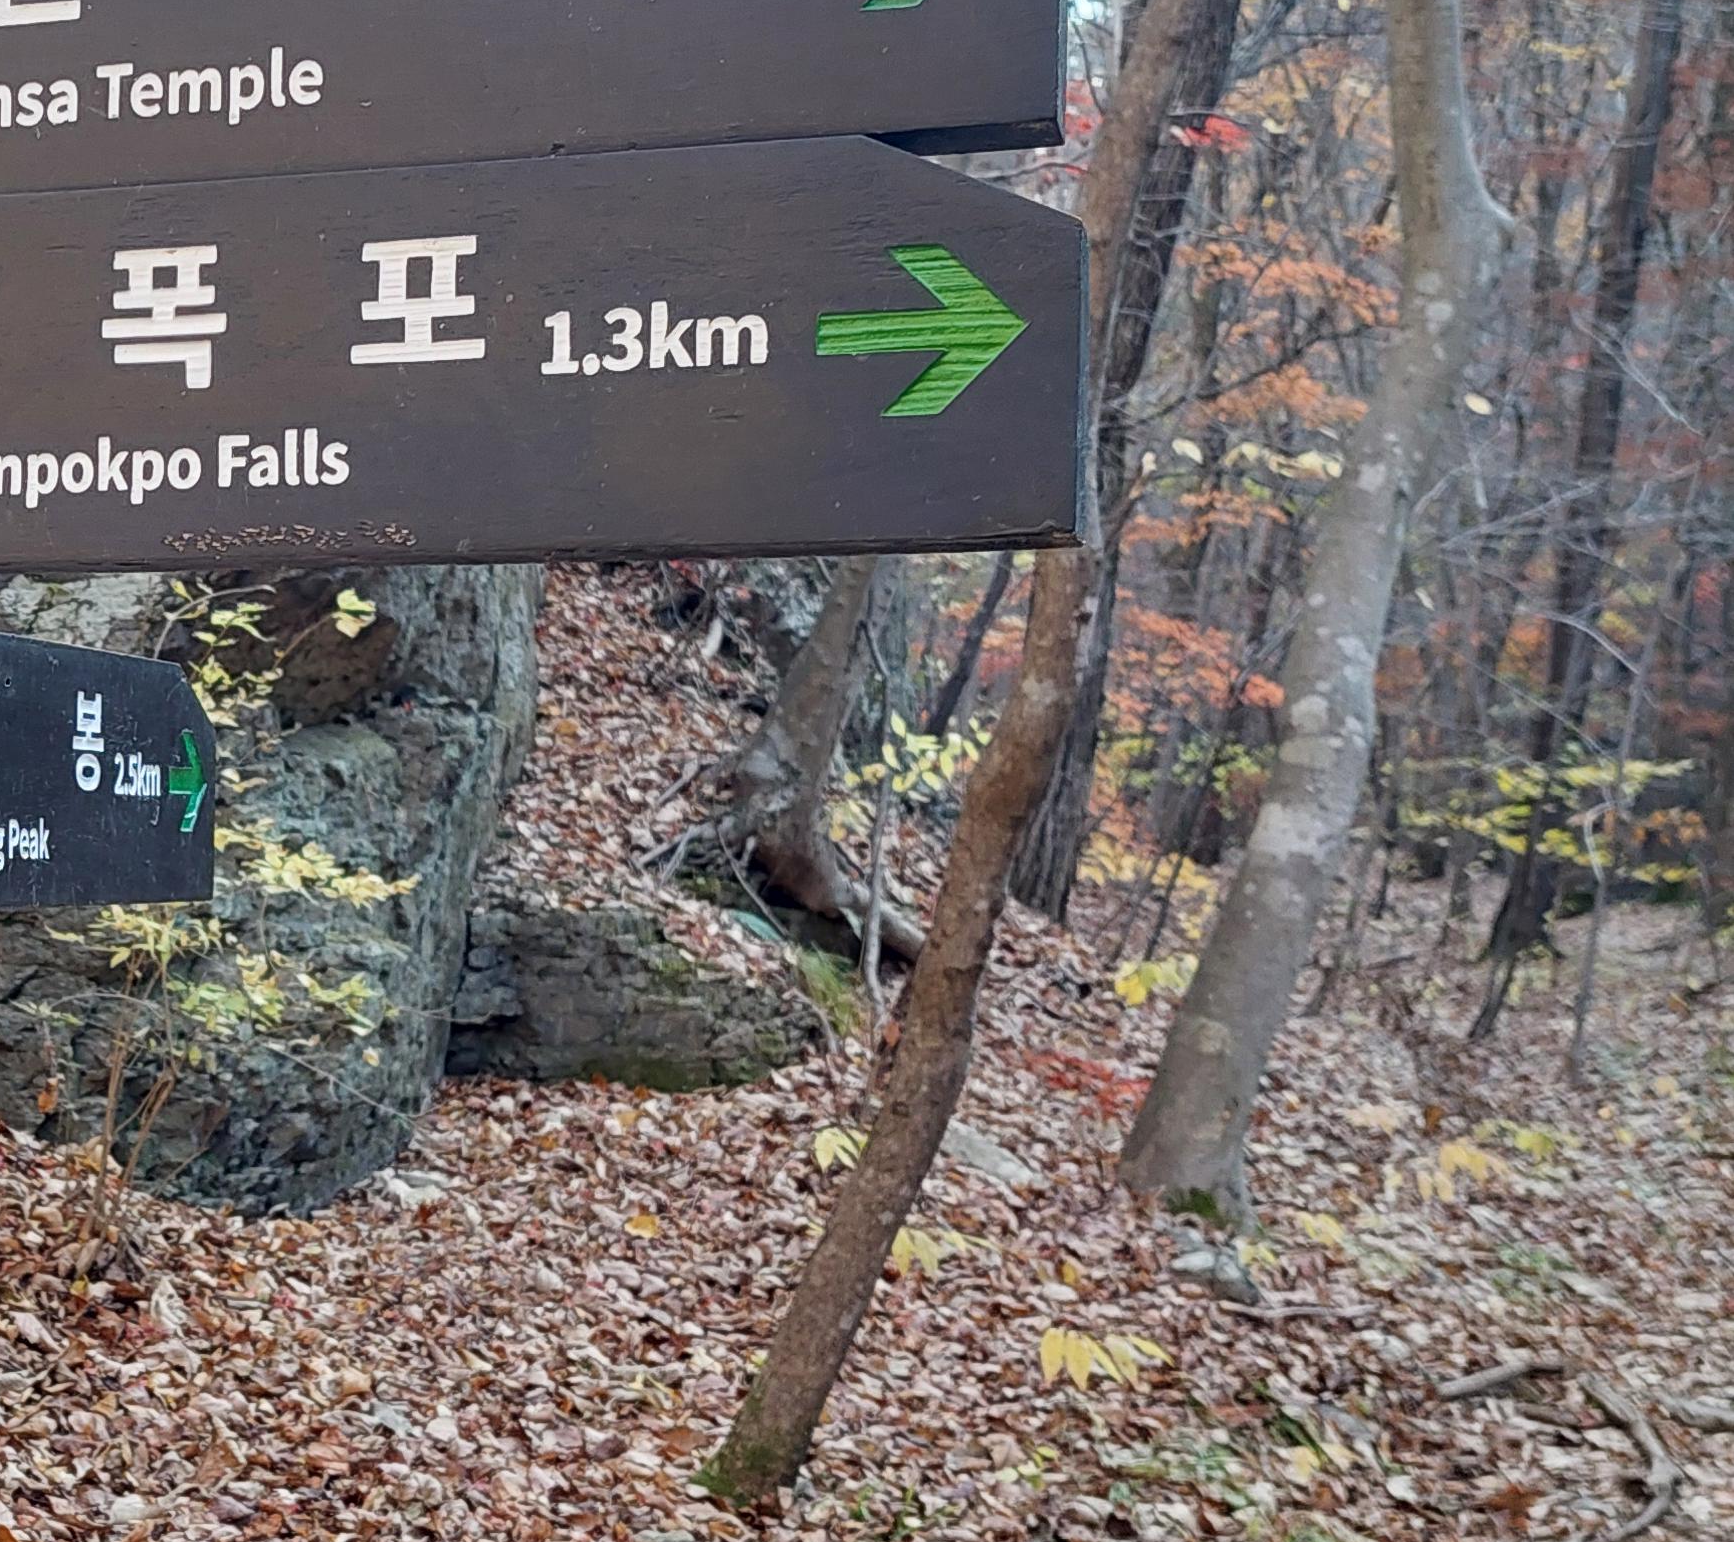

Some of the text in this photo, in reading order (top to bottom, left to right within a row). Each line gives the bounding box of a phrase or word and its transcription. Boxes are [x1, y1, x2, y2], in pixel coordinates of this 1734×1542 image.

[96, 46, 324, 125] Temple
[540, 300, 769, 376] 1.3km
[217, 427, 350, 489] Falls
[113, 751, 162, 797] 2.5km
[8, 816, 50, 861] Peak
